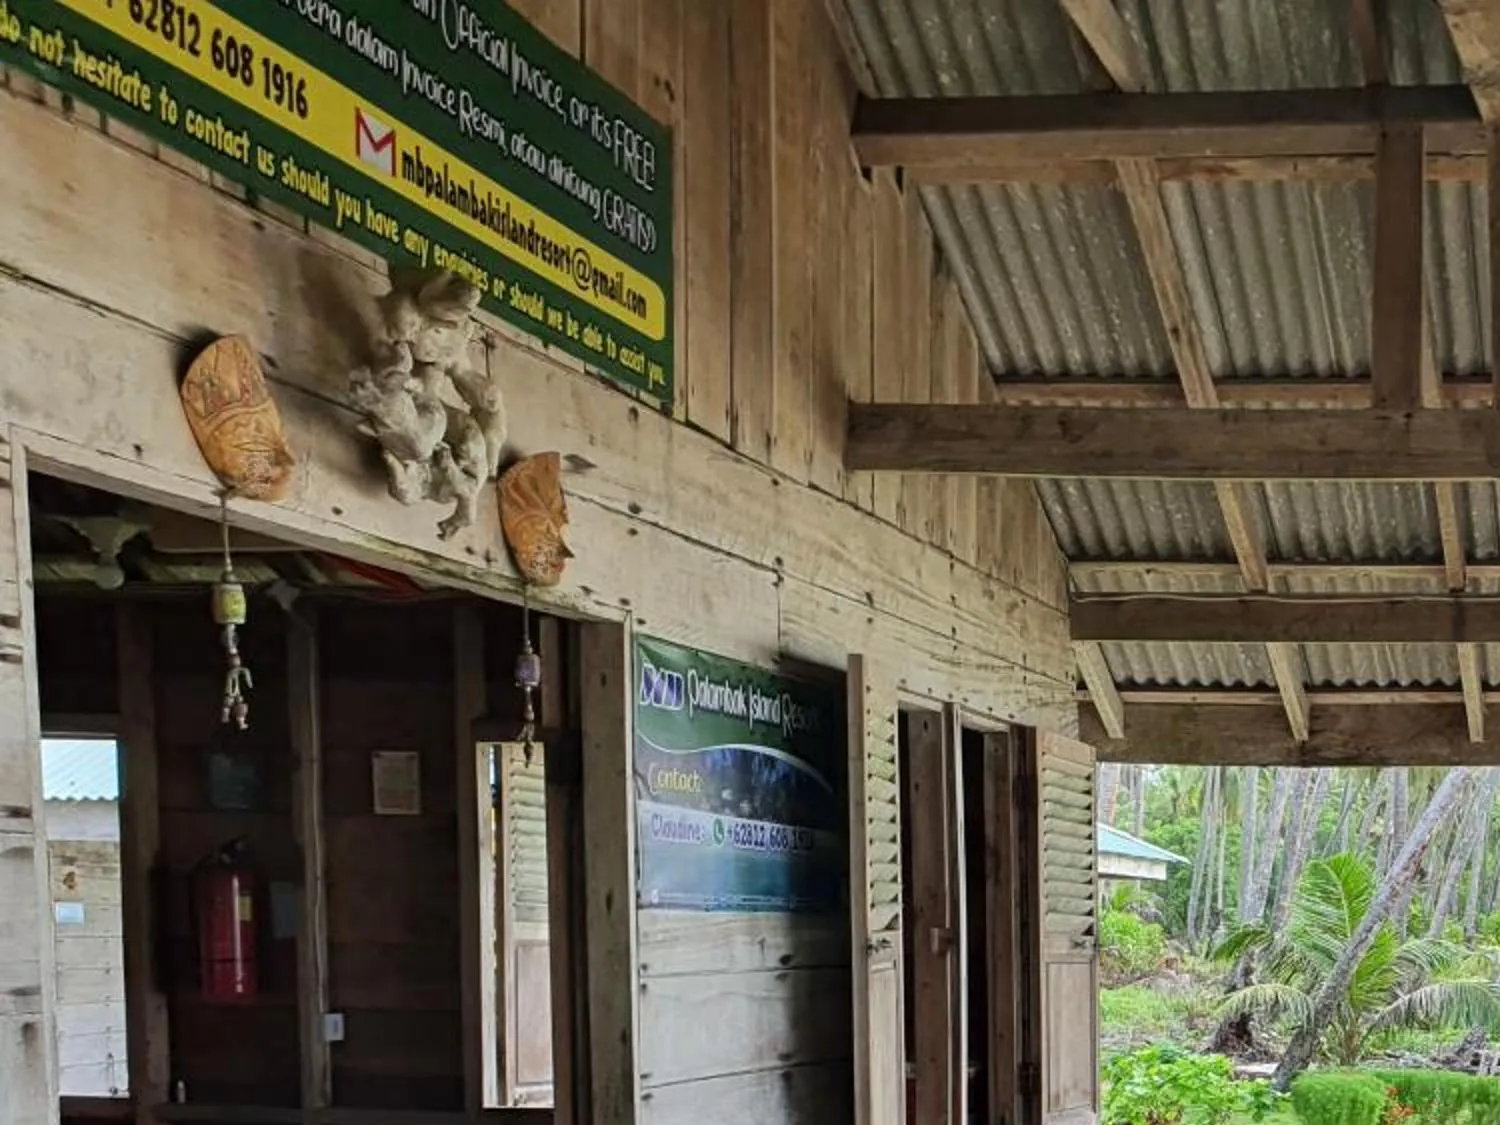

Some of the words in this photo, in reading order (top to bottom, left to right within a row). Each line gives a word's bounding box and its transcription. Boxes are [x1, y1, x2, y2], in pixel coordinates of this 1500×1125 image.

[211, 27, 254, 87] 608
[262, 57, 308, 119] 1916
[345, 16, 400, 76] dalam
[402, 49, 457, 116] Invoice
[29, 25, 65, 67] not
[73, 38, 152, 112] hesitate
[159, 85, 178, 126] to
[185, 107, 251, 165] contact
[256, 144, 275, 177] us
[281, 155, 330, 206] should
[335, 186, 361, 228] you
[365, 196, 400, 243] have
[403, 228, 430, 268] any
[510, 282, 545, 321] should
